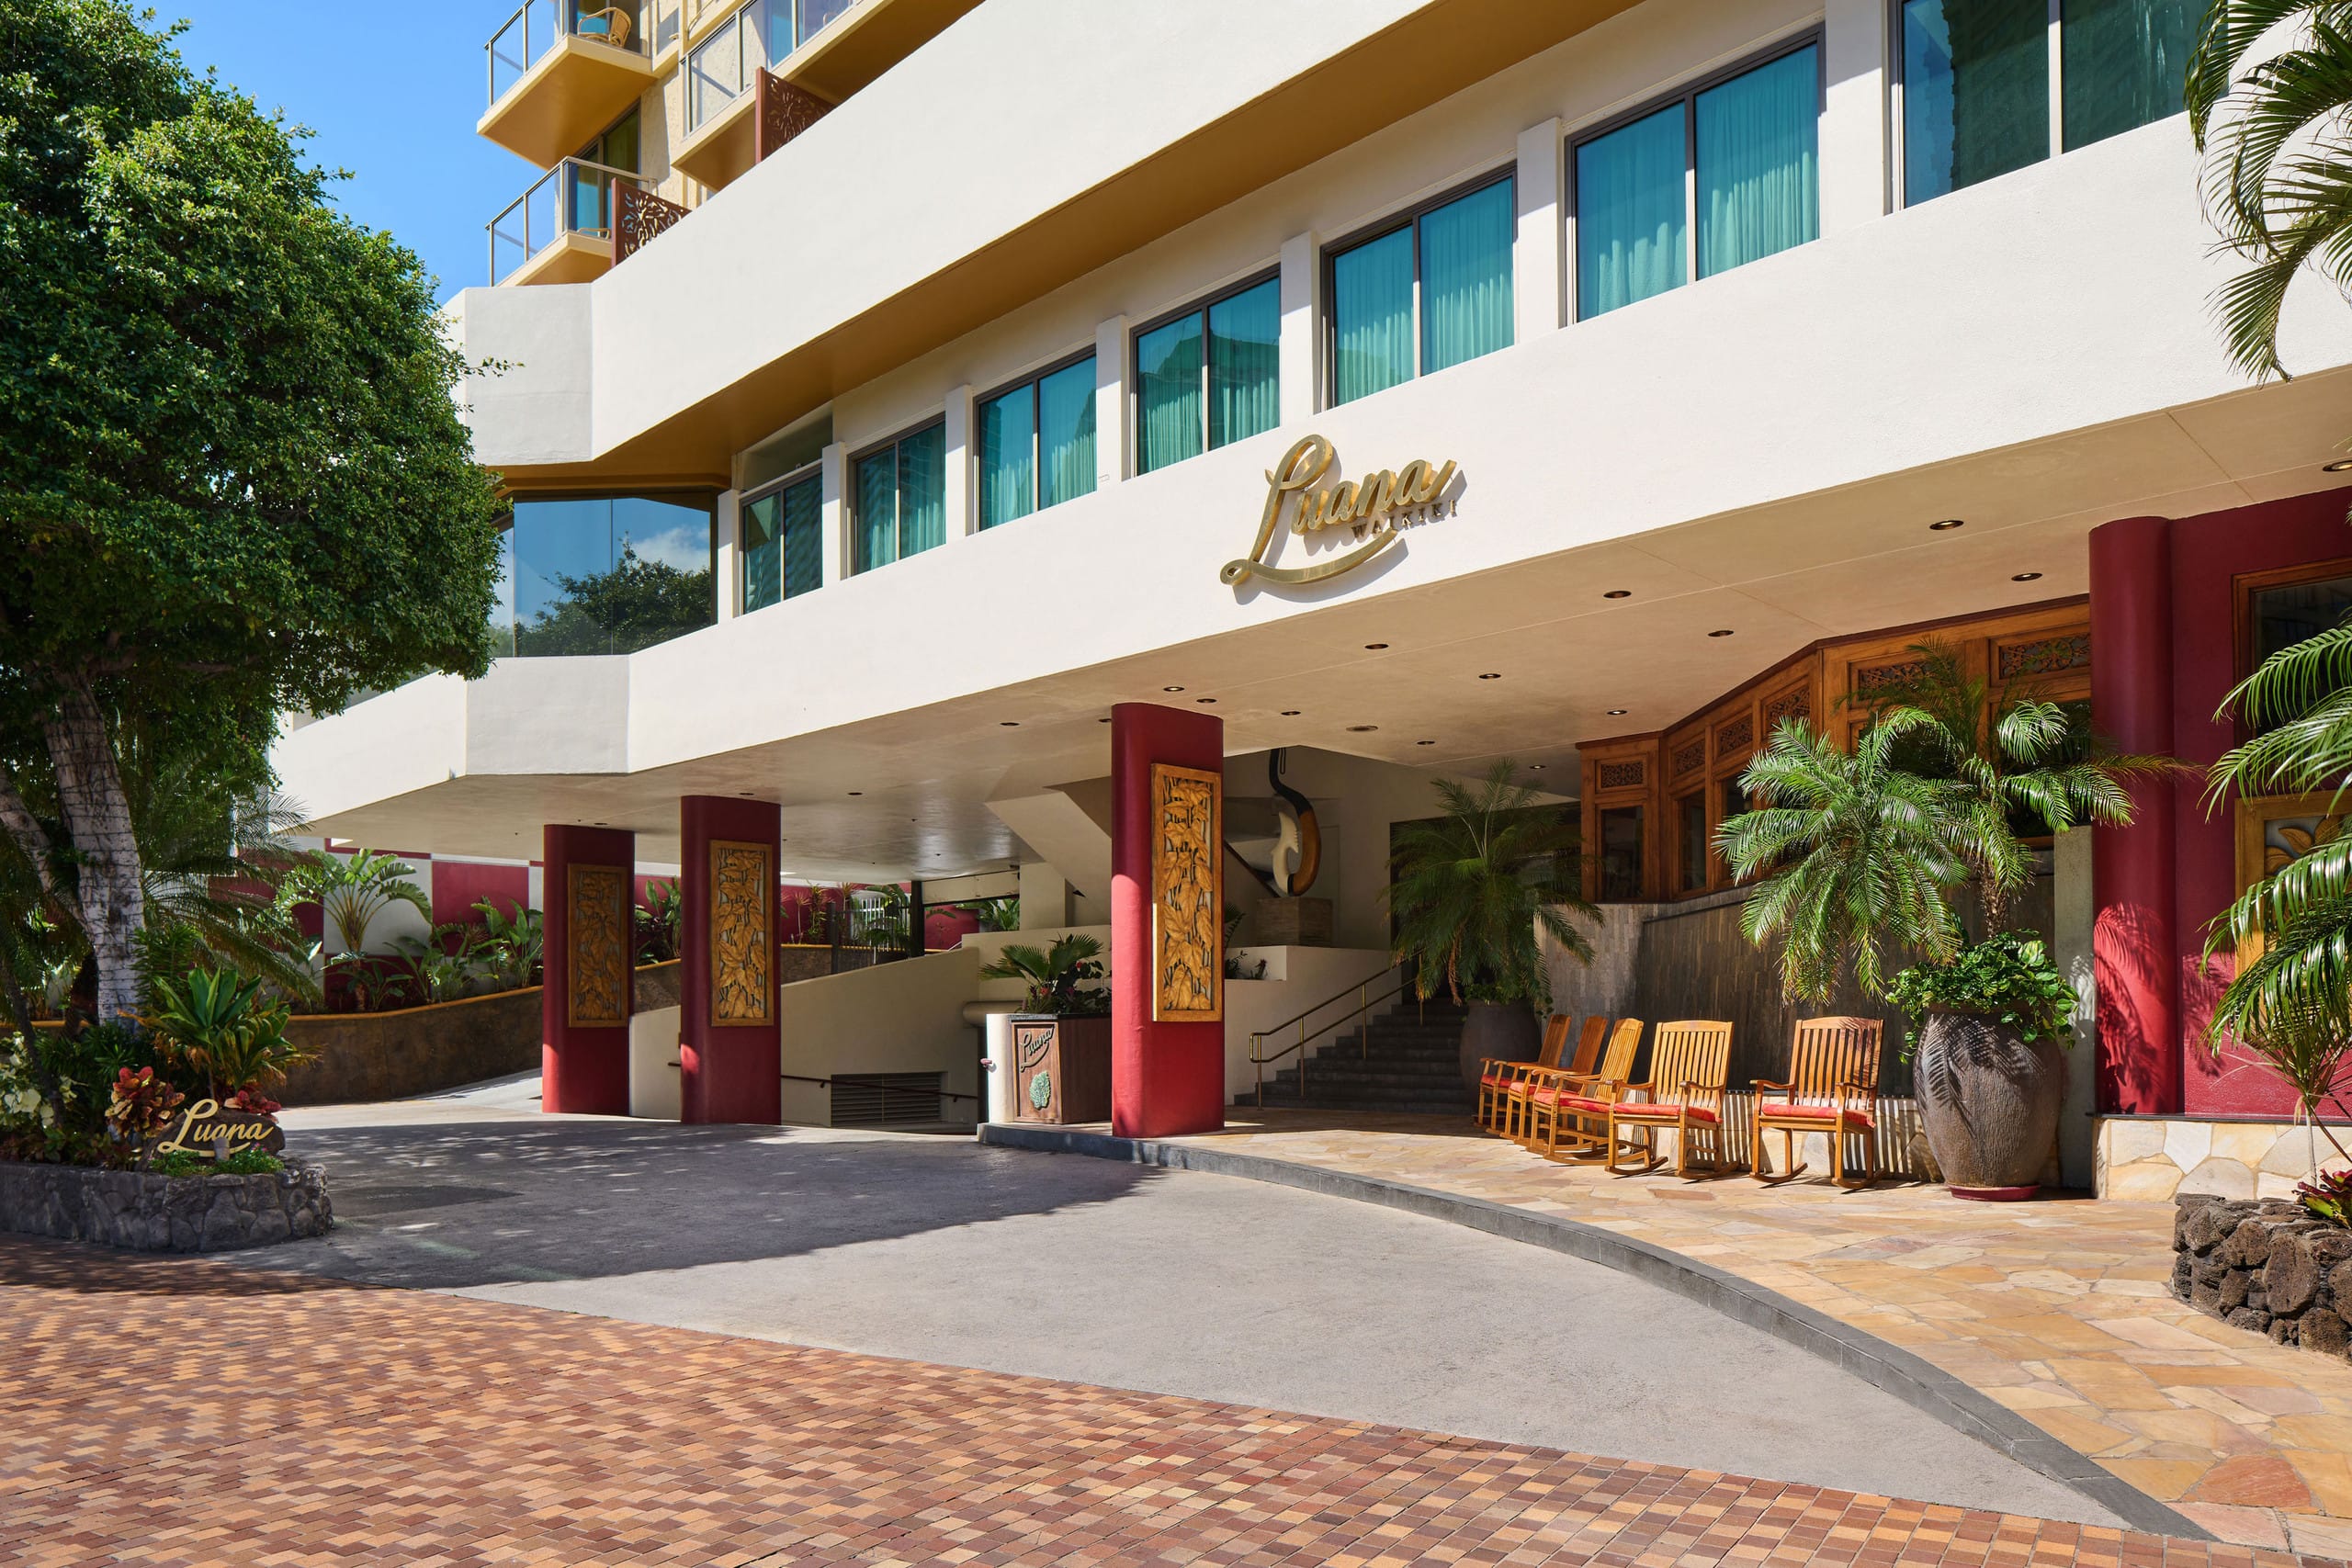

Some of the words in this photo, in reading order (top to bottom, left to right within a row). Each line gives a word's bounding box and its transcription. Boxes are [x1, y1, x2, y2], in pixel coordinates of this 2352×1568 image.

[1219, 434, 1458, 586] Luana
[1351, 499, 1457, 538] WAIKIKI
[1020, 1026, 1055, 1073] Luana
[157, 1099, 274, 1157] Luana
